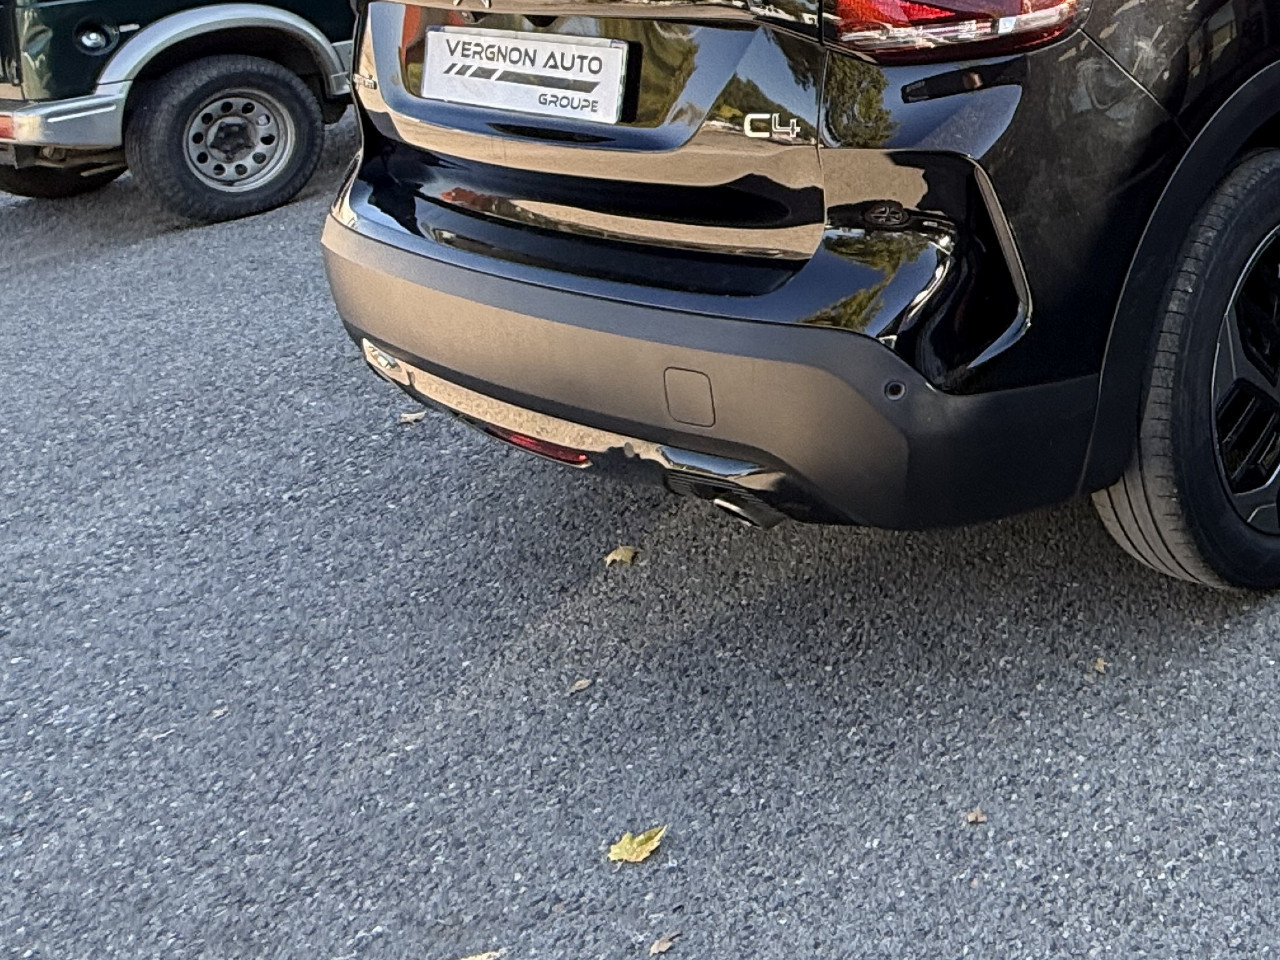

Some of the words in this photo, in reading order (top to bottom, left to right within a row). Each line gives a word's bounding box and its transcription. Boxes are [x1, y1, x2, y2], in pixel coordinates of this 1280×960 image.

[445, 39, 538, 68] VERGNON
[543, 51, 603, 75] AUTO
[538, 93, 599, 113] GROUPE
[743, 113, 802, 138] C4
